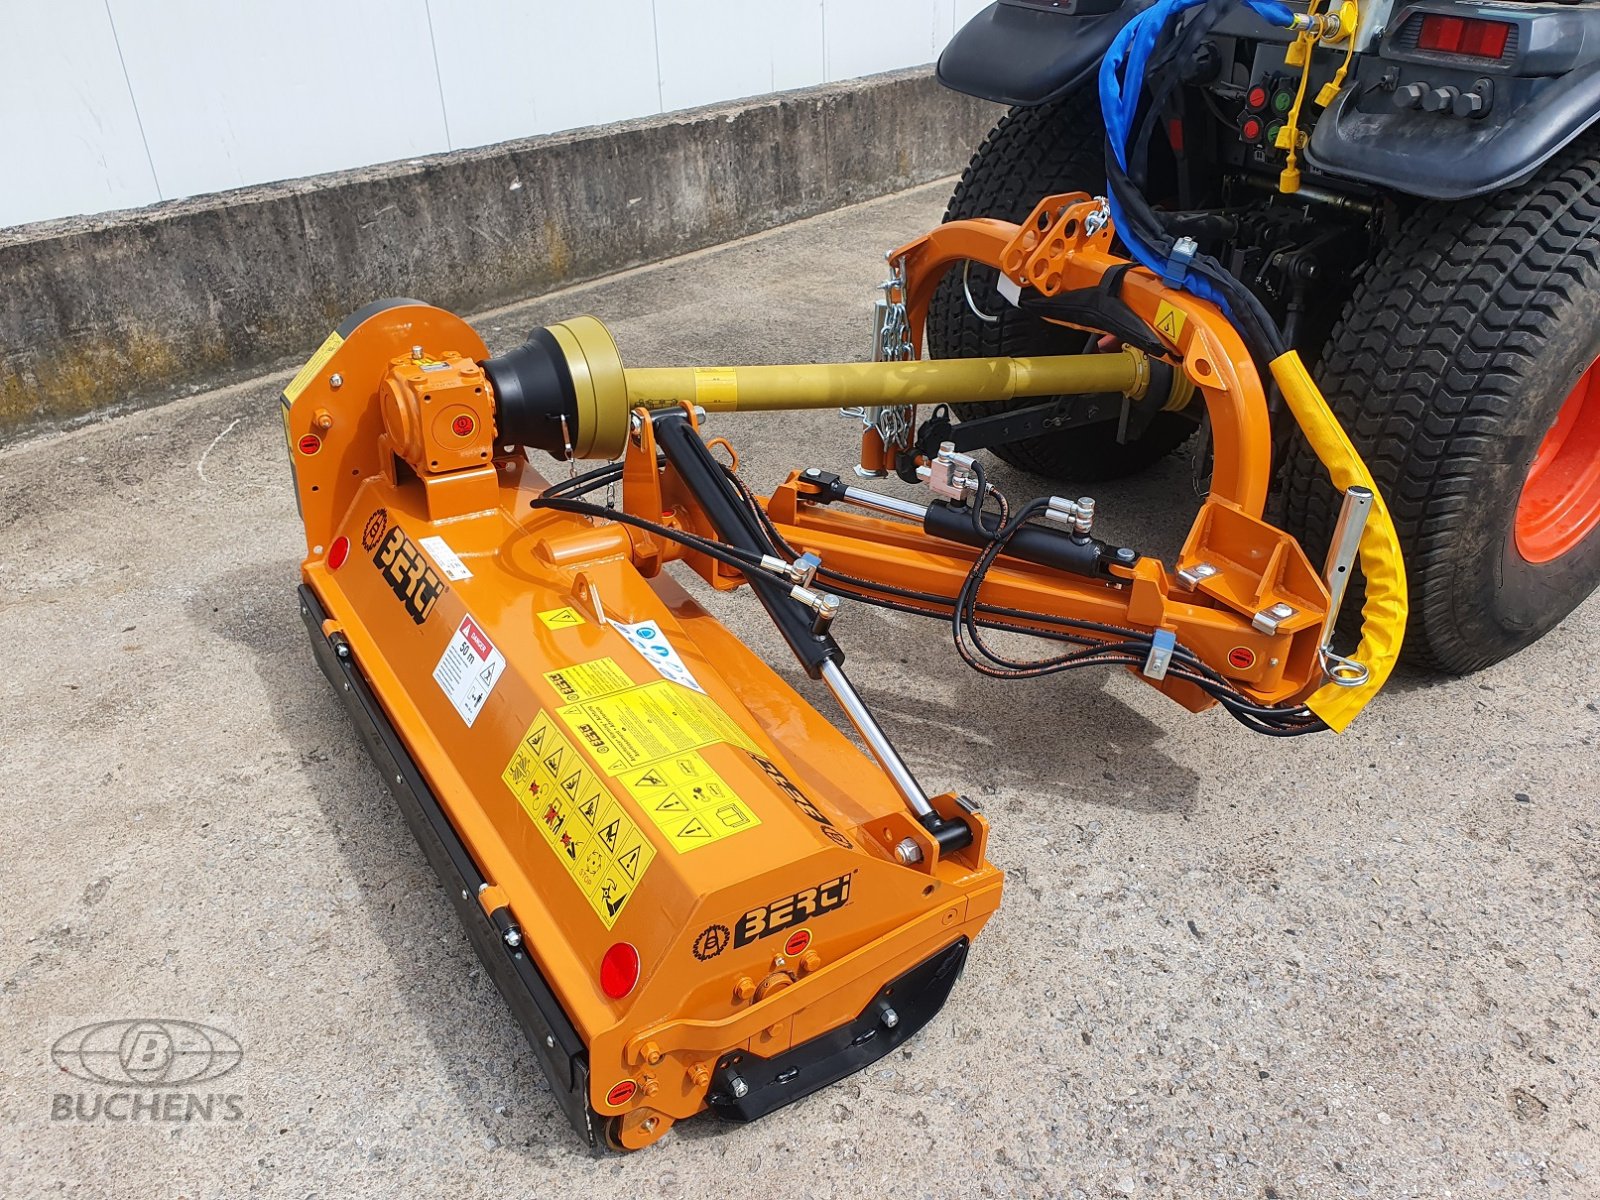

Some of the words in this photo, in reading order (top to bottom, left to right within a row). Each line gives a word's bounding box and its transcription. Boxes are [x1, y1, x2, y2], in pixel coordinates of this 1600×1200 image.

[458, 640, 473, 658] 50
[469, 631, 488, 655] DANGER
[577, 868, 593, 886] STOP
